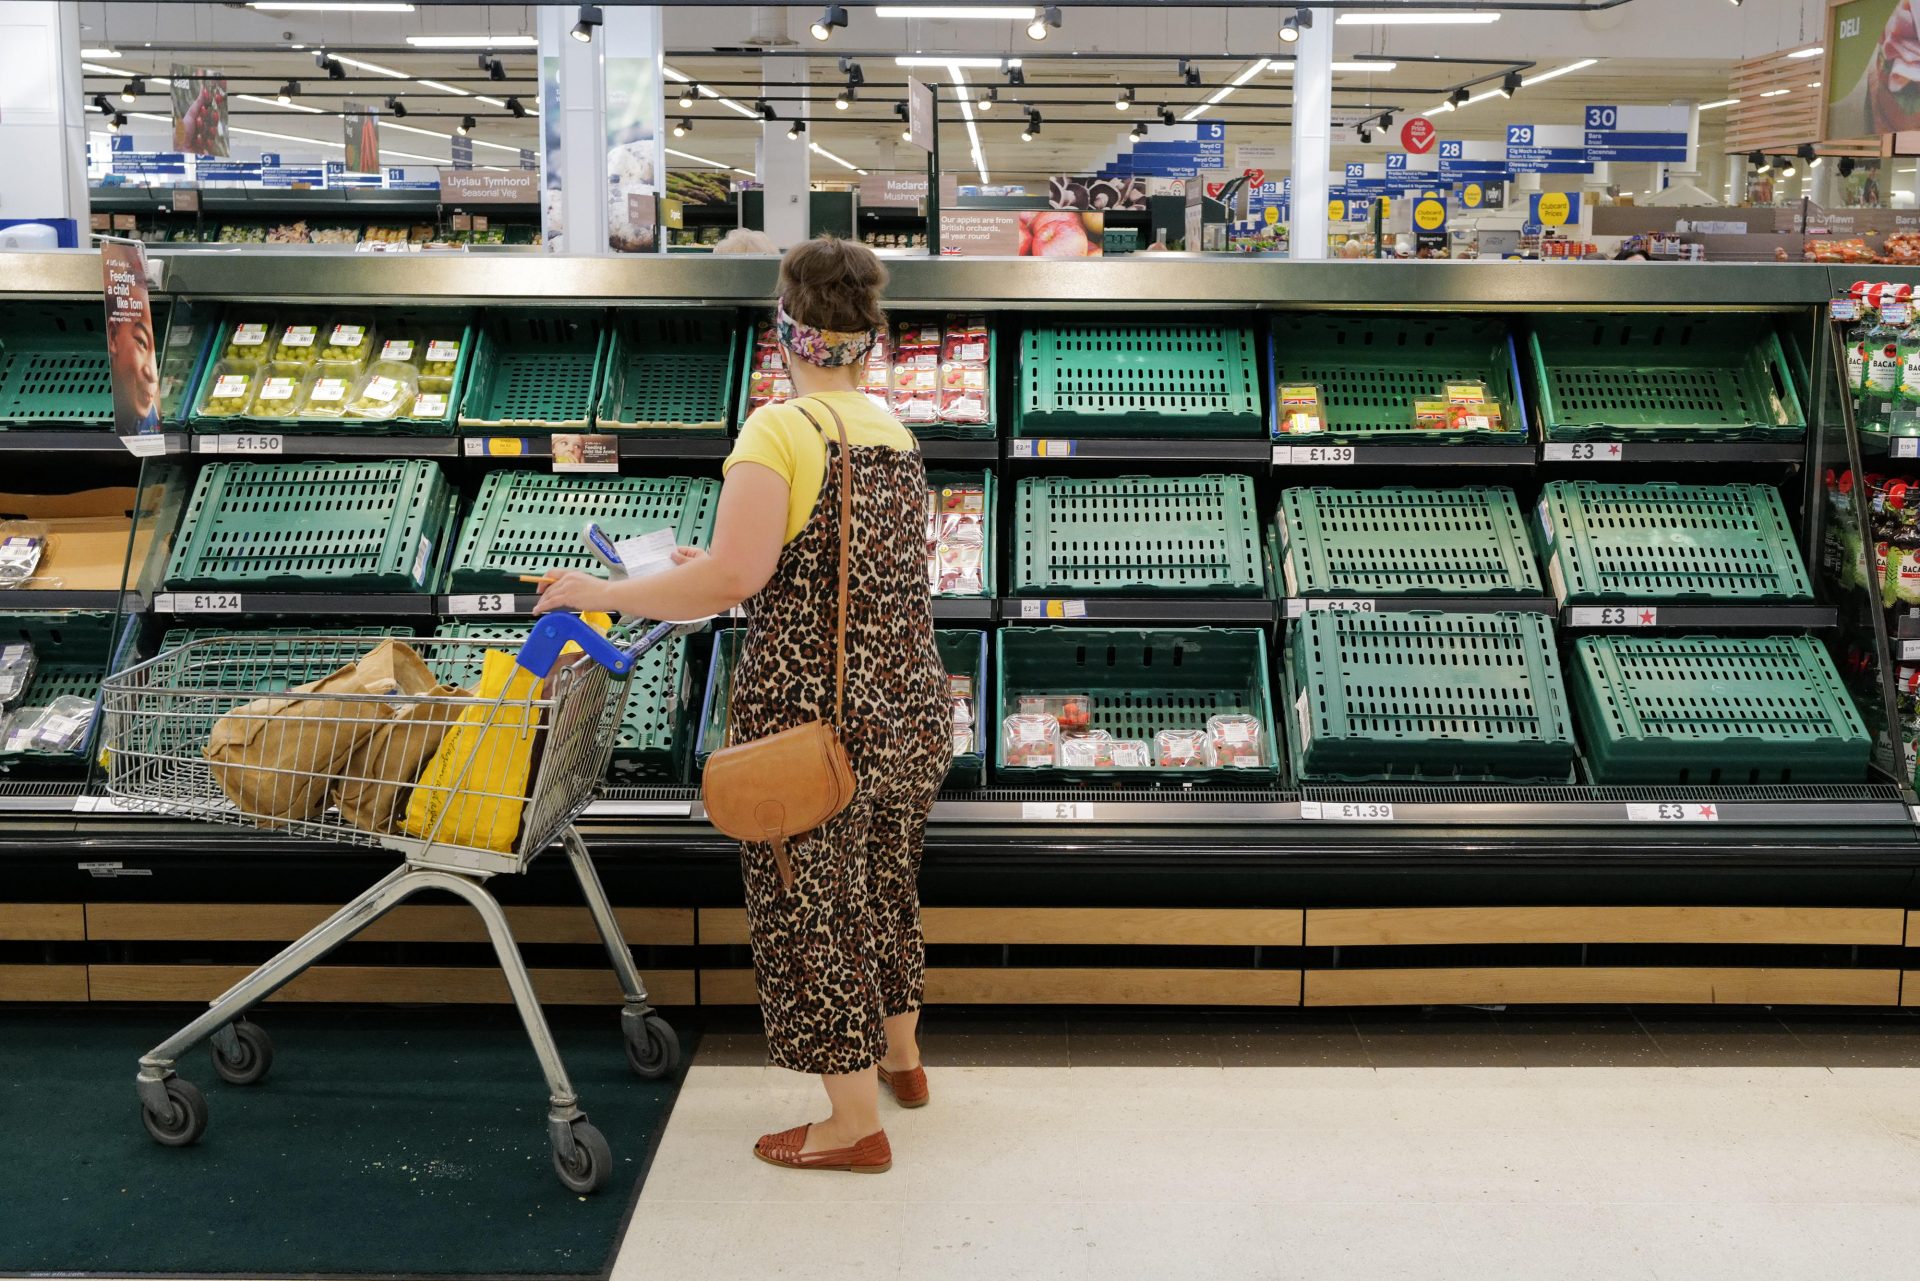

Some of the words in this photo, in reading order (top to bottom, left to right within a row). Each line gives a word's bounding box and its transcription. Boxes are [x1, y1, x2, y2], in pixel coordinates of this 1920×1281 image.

[1840, 17, 1860, 39] DELI
[1588, 109, 1615, 126] 30
[1210, 124, 1222, 138] 5
[1509, 128, 1531, 143] 29
[113, 137, 121, 150] 7
[1441, 144, 1460, 157] 28
[263, 155, 272, 167] 9
[1388, 156, 1404, 167] 27
[328, 164, 341, 174] 10
[390, 170, 400, 180] 11
[1347, 165, 1362, 176] 26
[447, 176, 481, 187] Llysiau
[483, 176, 530, 188] Tymhorol
[1263, 184, 1275, 192] 23
[462, 188, 498, 197] Seasonal
[500, 188, 517, 198] Veg
[956, 216, 980, 225] apples
[995, 216, 1013, 224] from
[1896, 216, 1916, 224] Bara
[966, 224, 1000, 232] orchards,
[110, 269, 136, 287] Feeding
[107, 285, 112, 295] a
[113, 283, 130, 296] child
[116, 296, 129, 309] like
[129, 297, 143, 310] Tom
[237, 437, 279, 449] £1.50
[1310, 449, 1352, 461] £1.39
[1571, 444, 1594, 459] £3
[194, 596, 239, 609] £1.24
[478, 595, 502, 612] £3
[1601, 608, 1625, 624] £3
[1055, 804, 1078, 819] £1
[1343, 804, 1390, 818] £1.39
[1658, 804, 1685, 820] £3
